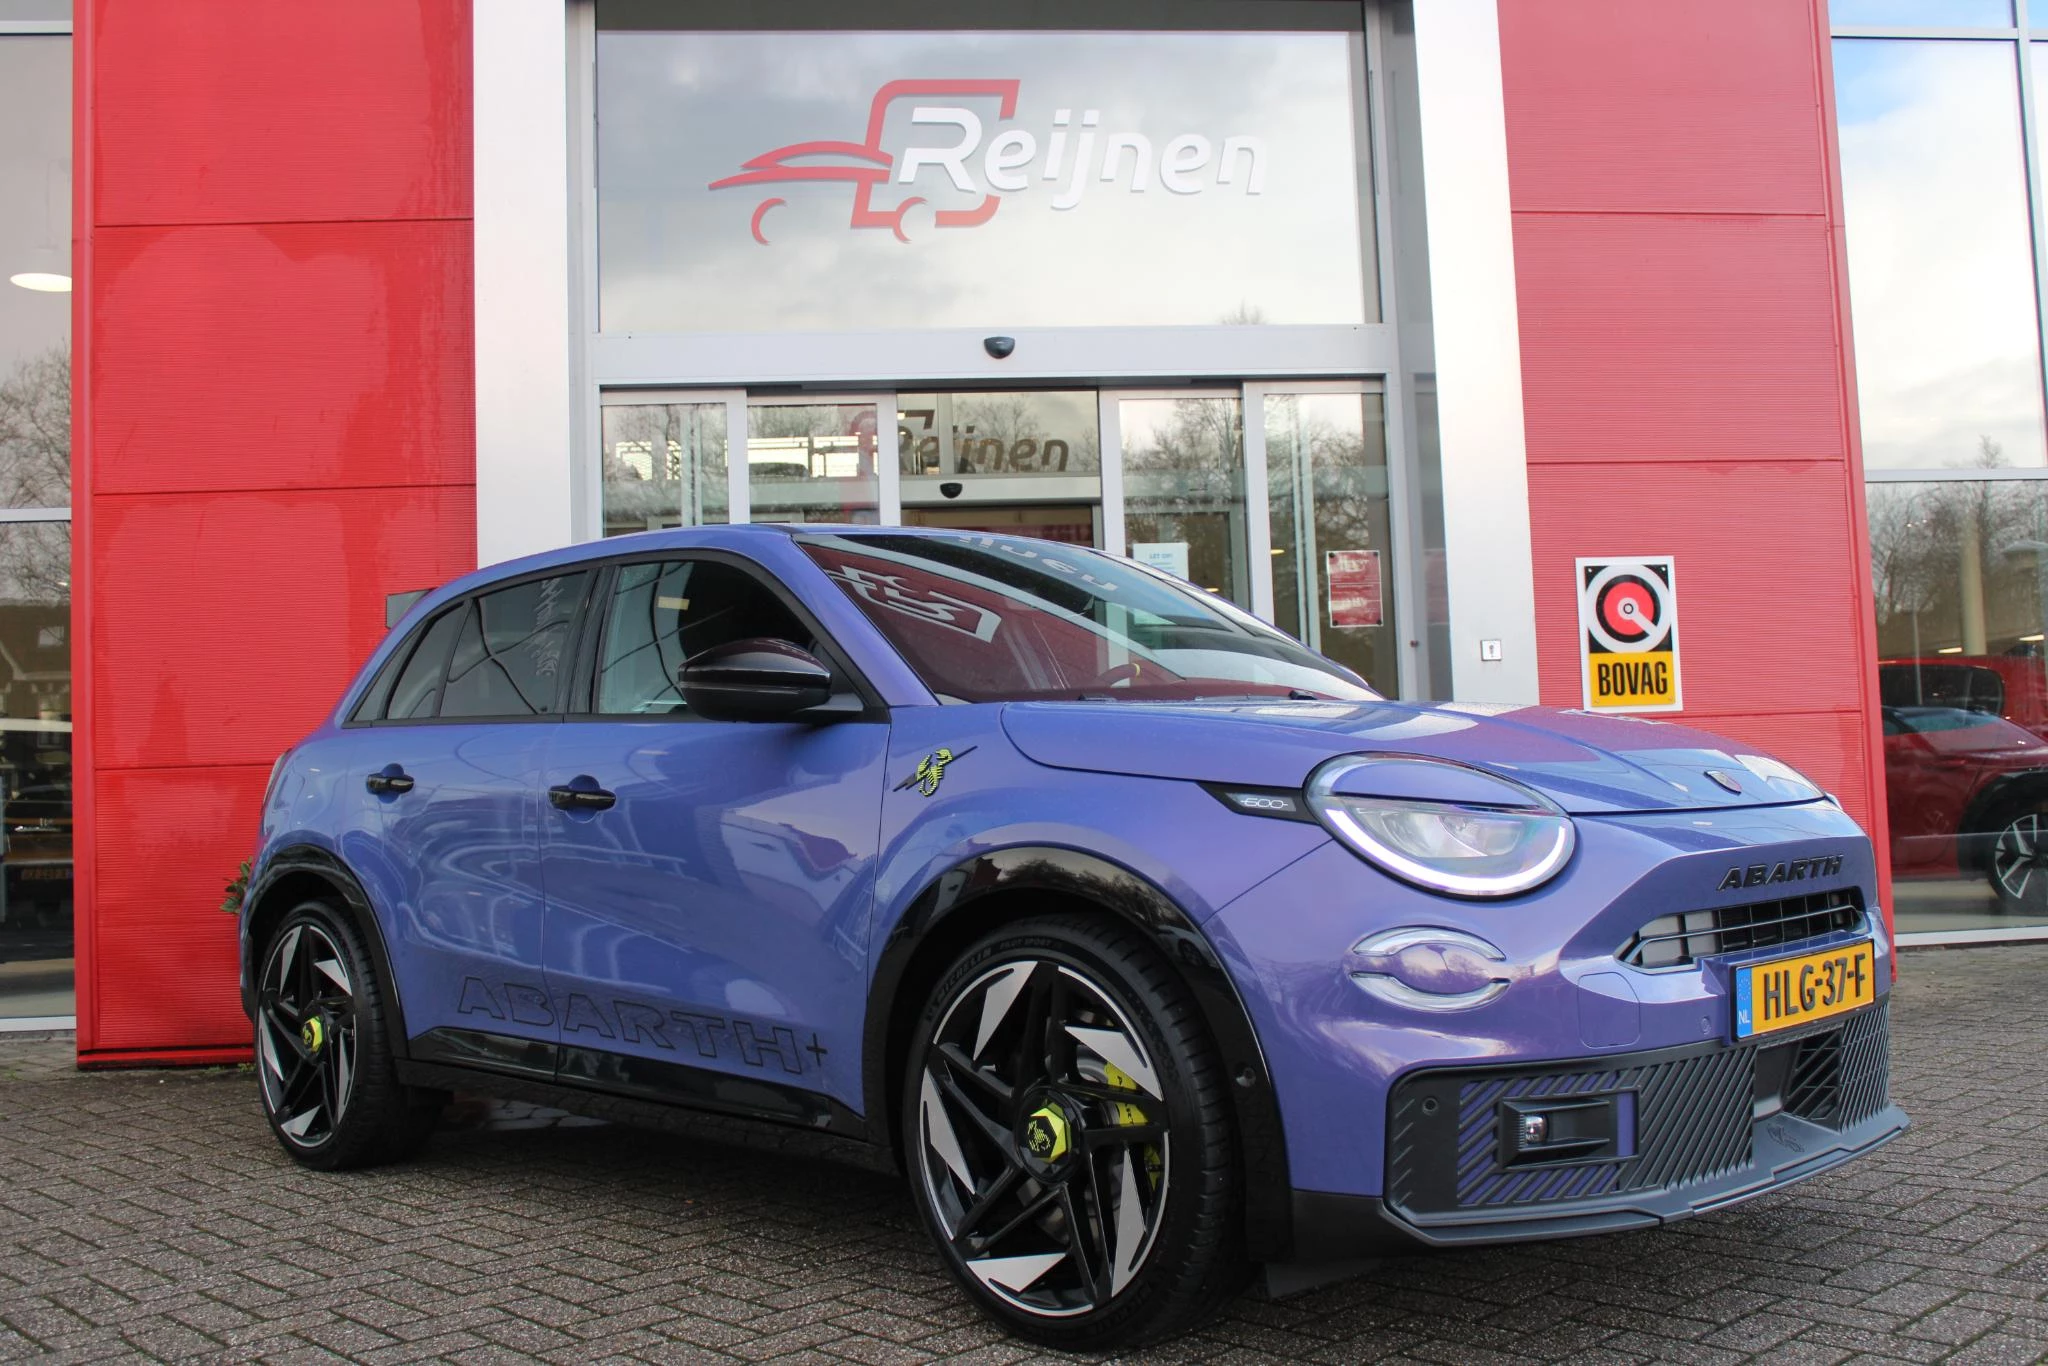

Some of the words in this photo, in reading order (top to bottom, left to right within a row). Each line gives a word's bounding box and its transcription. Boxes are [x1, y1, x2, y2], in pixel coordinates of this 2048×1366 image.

[898, 106, 1263, 210] Reijnen
[1598, 661, 1668, 696] BOVAG
[1242, 797, 1288, 809] 600
[1717, 854, 1844, 891] ABARTH
[1764, 953, 1866, 1021] HLG-37-F
[1738, 1010, 1751, 1025] NL
